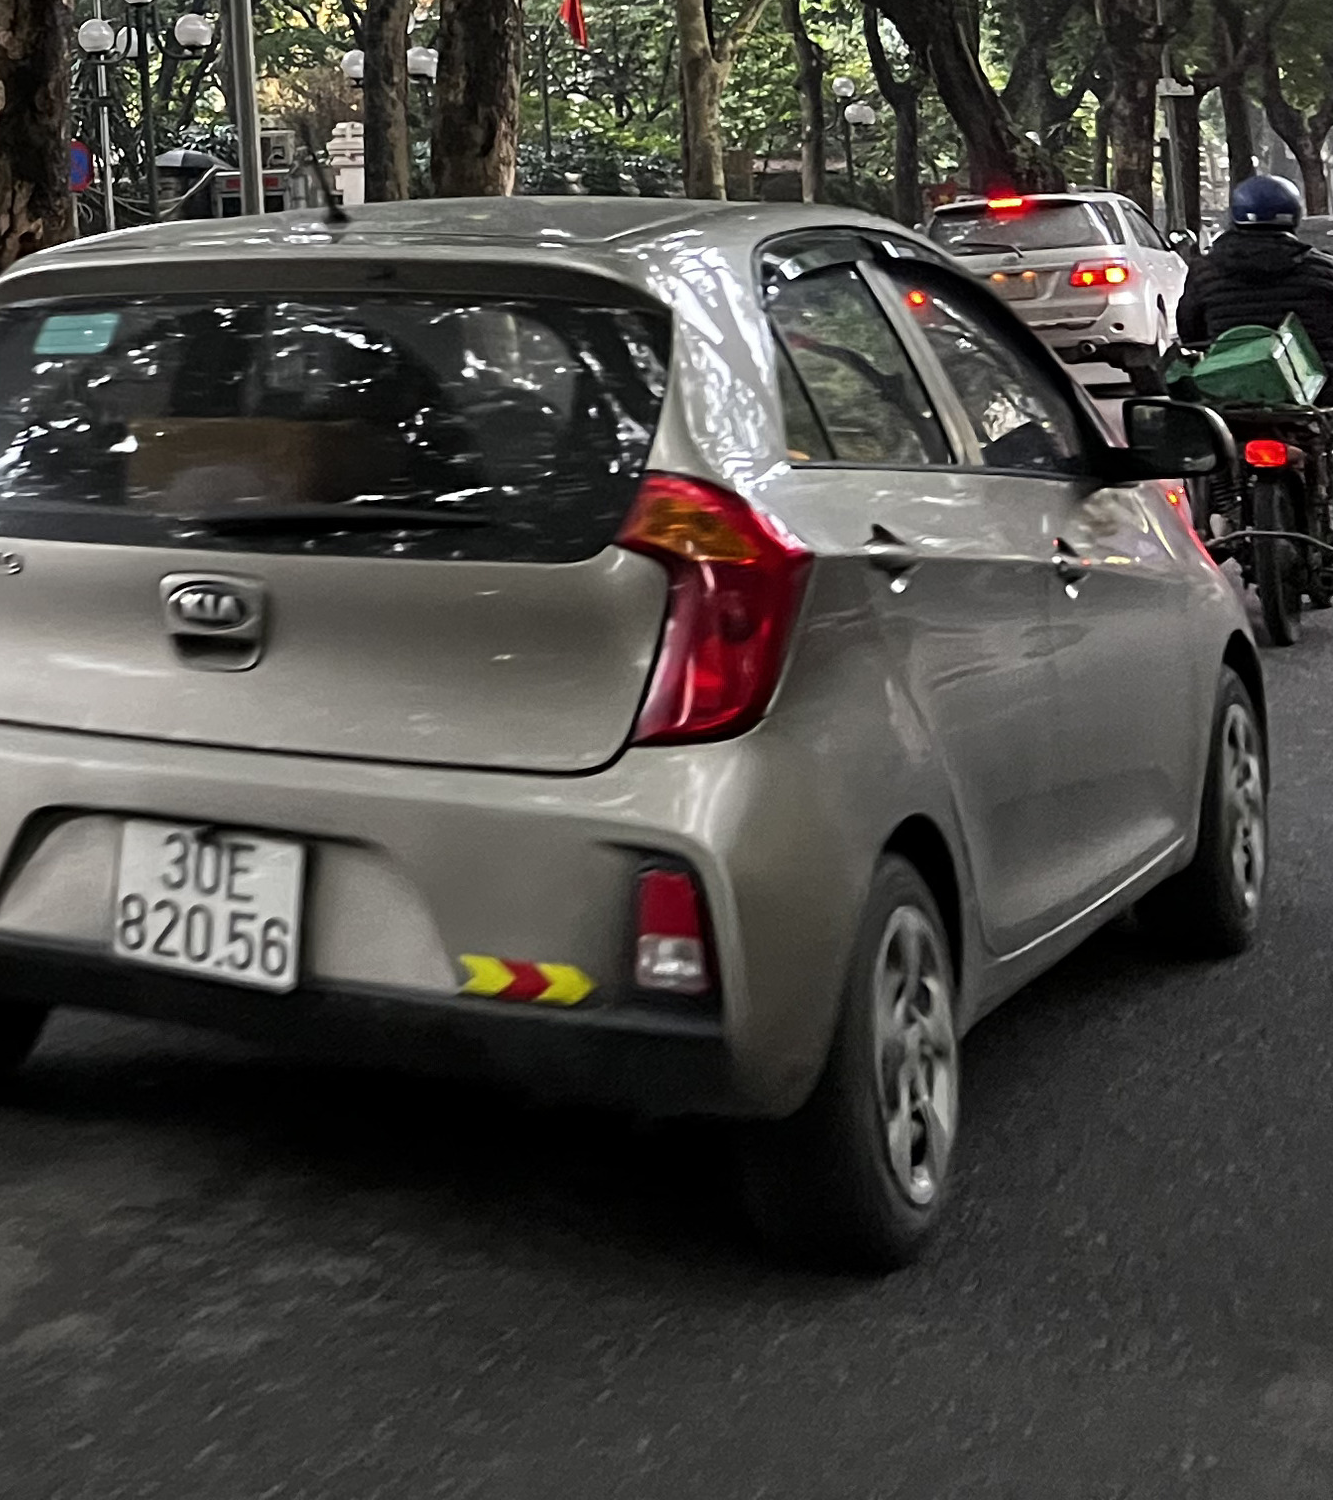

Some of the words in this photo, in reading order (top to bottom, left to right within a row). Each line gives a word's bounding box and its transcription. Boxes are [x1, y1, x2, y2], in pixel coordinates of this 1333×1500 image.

[179, 591, 242, 623] KIA
[161, 832, 256, 903] 30E
[119, 892, 290, 978] 820.56
